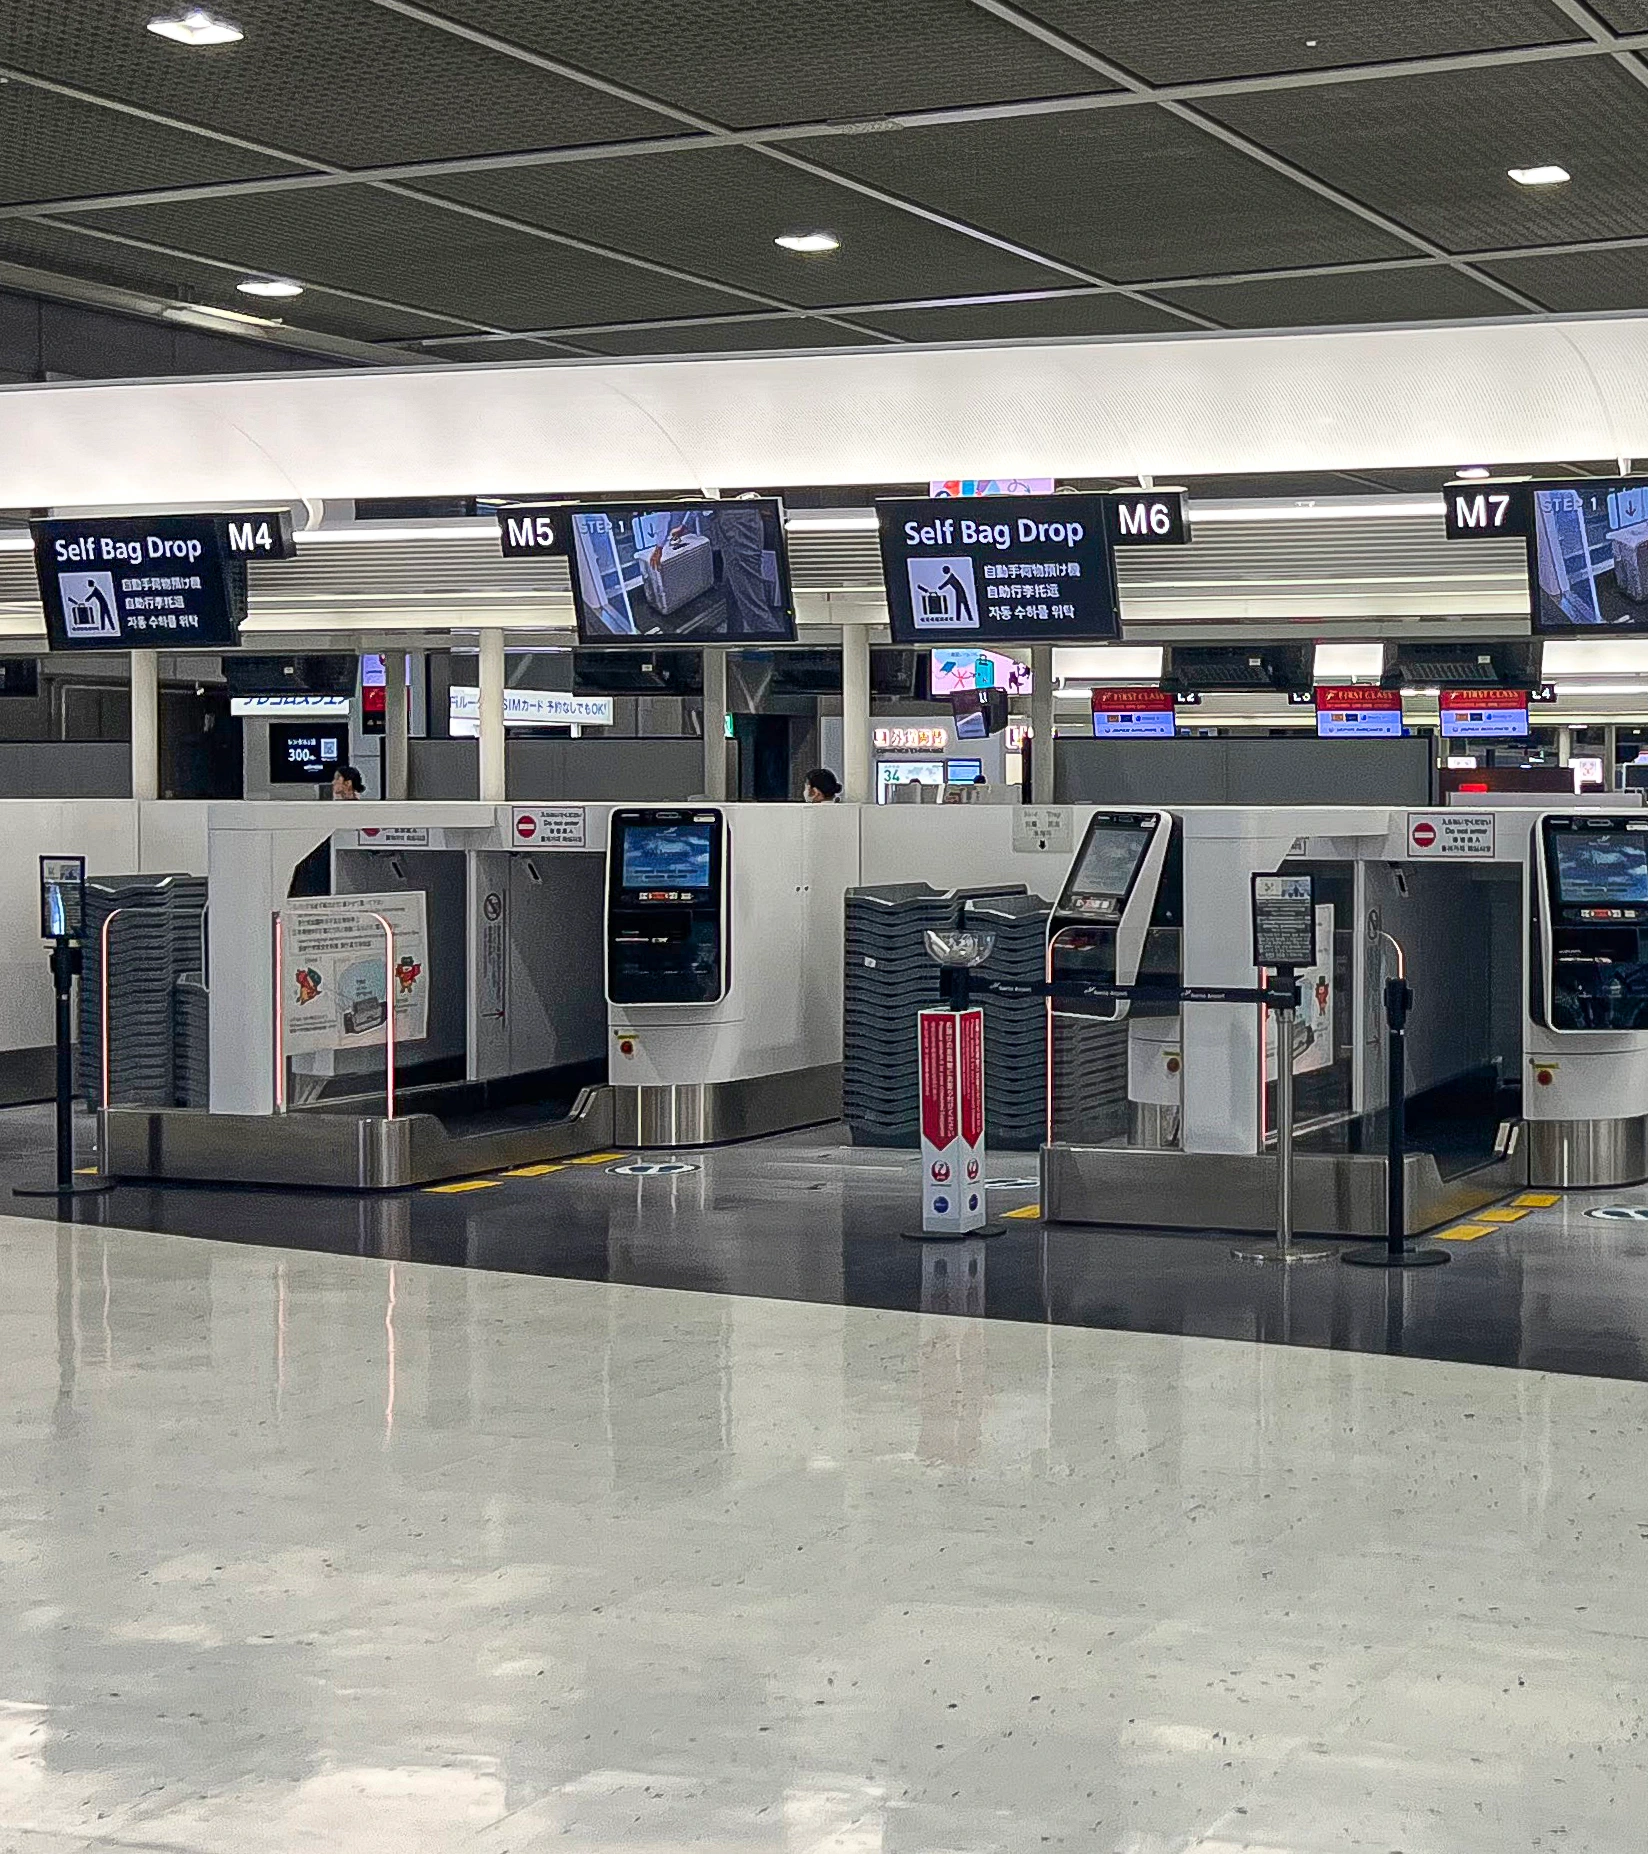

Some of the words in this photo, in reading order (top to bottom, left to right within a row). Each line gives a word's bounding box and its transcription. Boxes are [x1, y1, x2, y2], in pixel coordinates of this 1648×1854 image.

[1118, 503, 1170, 535] M6
[1455, 495, 1510, 528] M7
[1542, 498, 1583, 513] STEP
[1590, 497, 1597, 511] 1
[228, 522, 272, 551] M4
[507, 517, 554, 547] M5
[580, 520, 613, 534] STEP
[619, 520, 625, 533] 1
[904, 520, 955, 546] Self
[961, 521, 1011, 549] Bag
[1017, 519, 1084, 548] Drop
[55, 537, 95, 562] Self
[101, 538, 142, 565] Bag
[147, 536, 202, 563] Drop
[883, 769, 900, 782] 34
